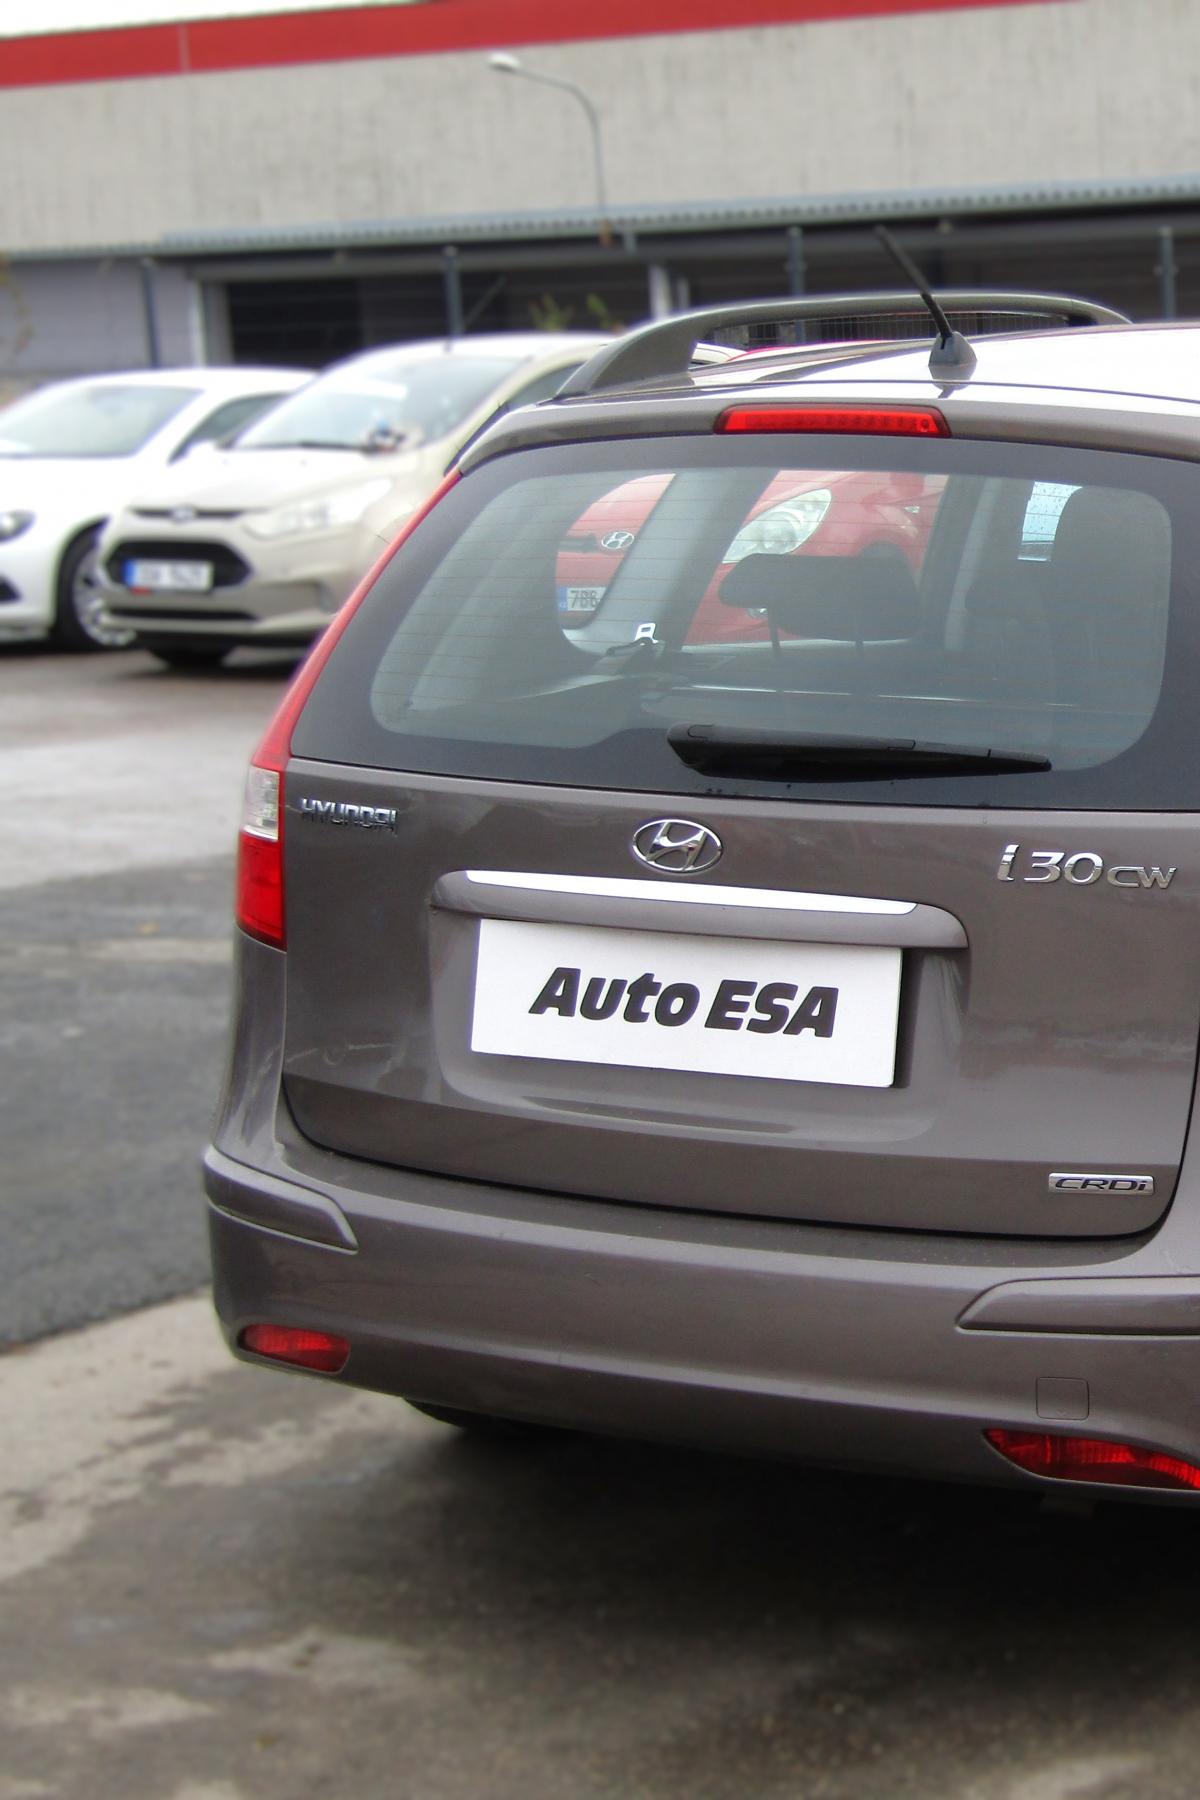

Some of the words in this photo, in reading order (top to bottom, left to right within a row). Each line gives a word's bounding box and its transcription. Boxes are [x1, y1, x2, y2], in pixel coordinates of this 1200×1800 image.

[302, 798, 397, 829] HYUNDAI
[528, 966, 700, 1027] Auto
[704, 979, 839, 1038] ESA
[1055, 1178, 1148, 1191] CRDi
